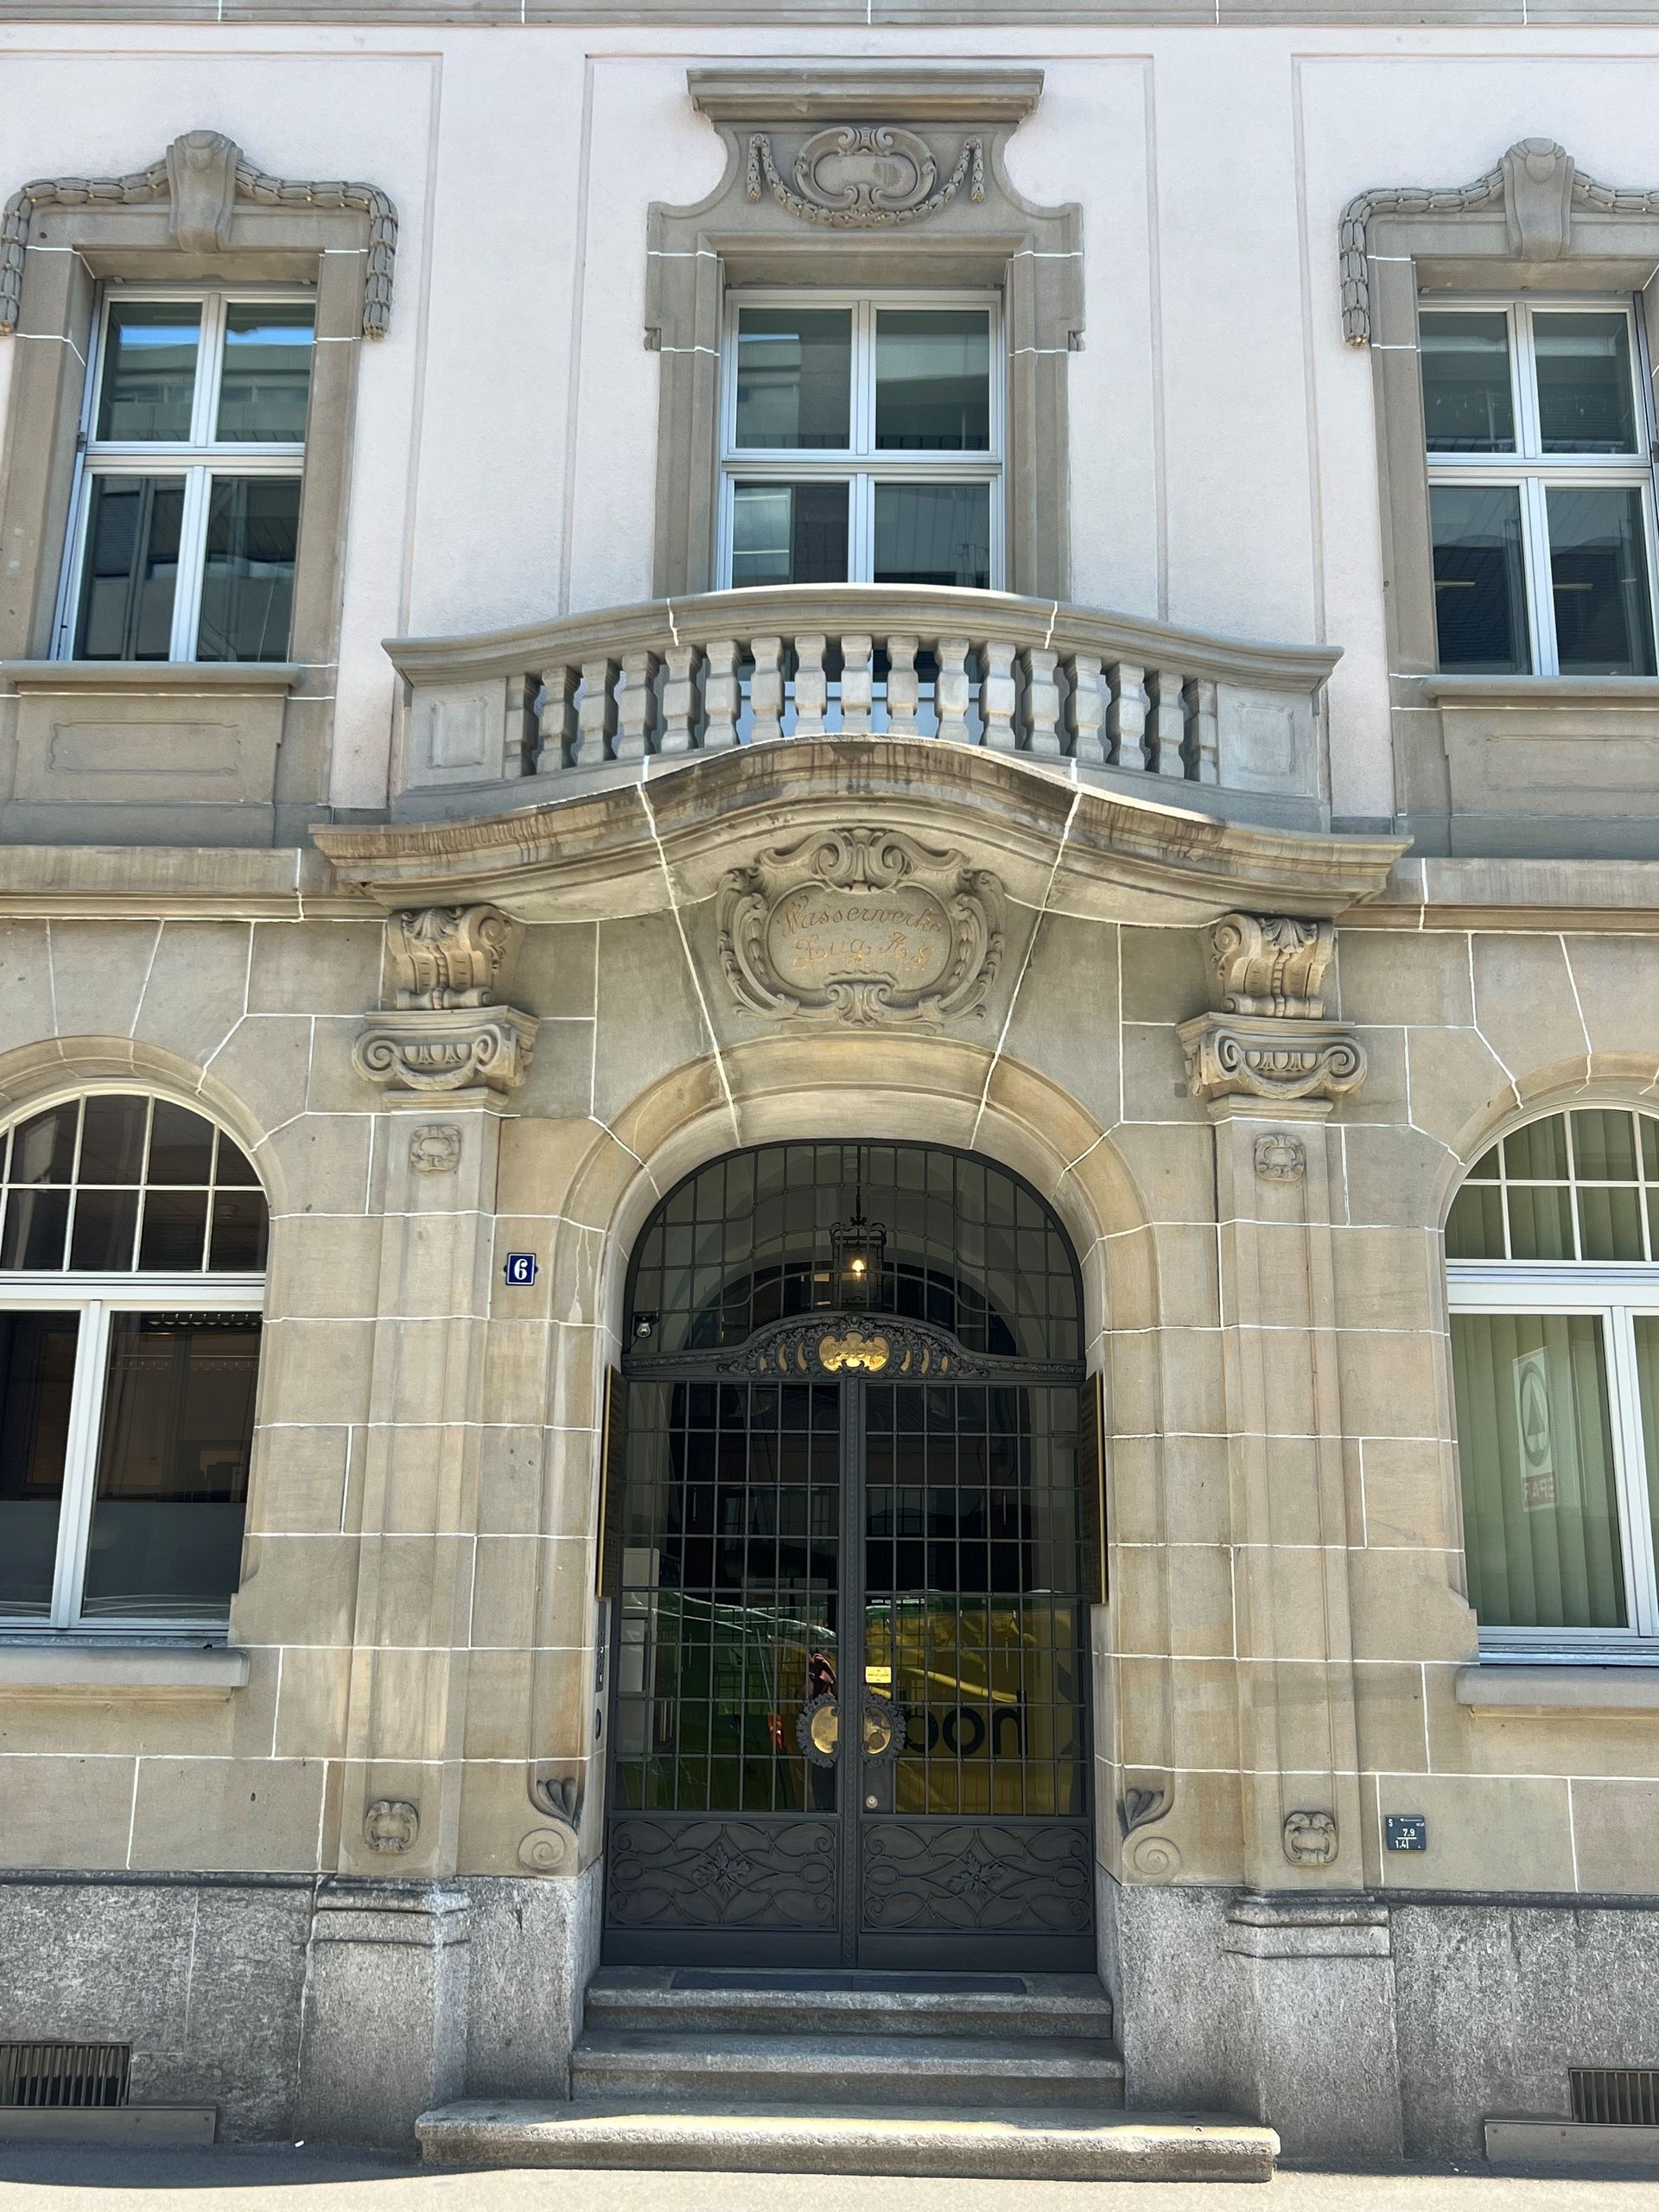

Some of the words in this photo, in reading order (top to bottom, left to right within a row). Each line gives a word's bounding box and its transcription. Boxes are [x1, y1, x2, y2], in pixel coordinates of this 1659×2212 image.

[514, 1258, 528, 1280] 6
[1388, 1818, 1394, 1827] S
[1402, 1827, 1415, 1837] 7.9
